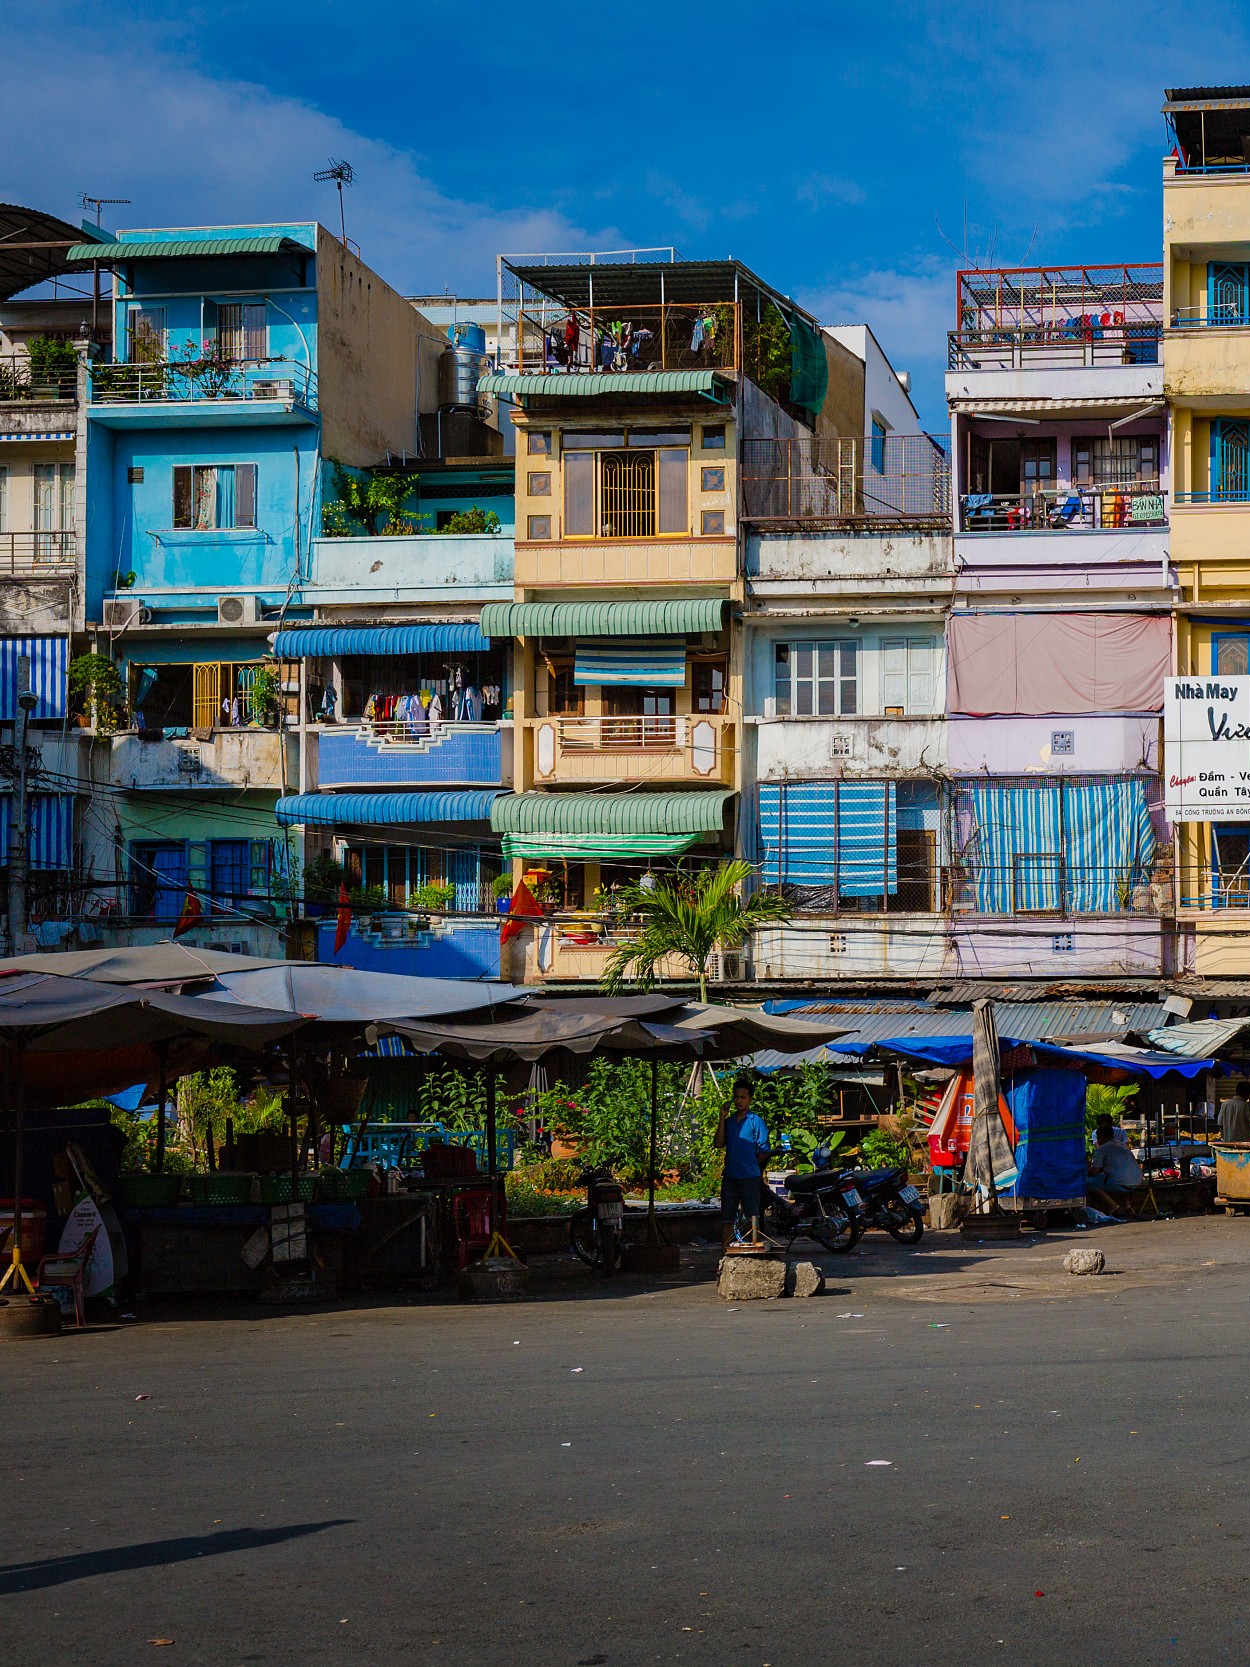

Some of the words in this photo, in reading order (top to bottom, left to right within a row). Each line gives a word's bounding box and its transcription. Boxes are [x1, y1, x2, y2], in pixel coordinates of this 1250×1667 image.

[1175, 682, 1204, 700] Nhà
[1206, 682, 1238, 702] May
[1170, 774, 1196, 788] Chuyên:
[1199, 771, 1225, 782] Đầm
[1199, 786, 1228, 798] Quần
[1184, 808, 1200, 816] CÔNG
